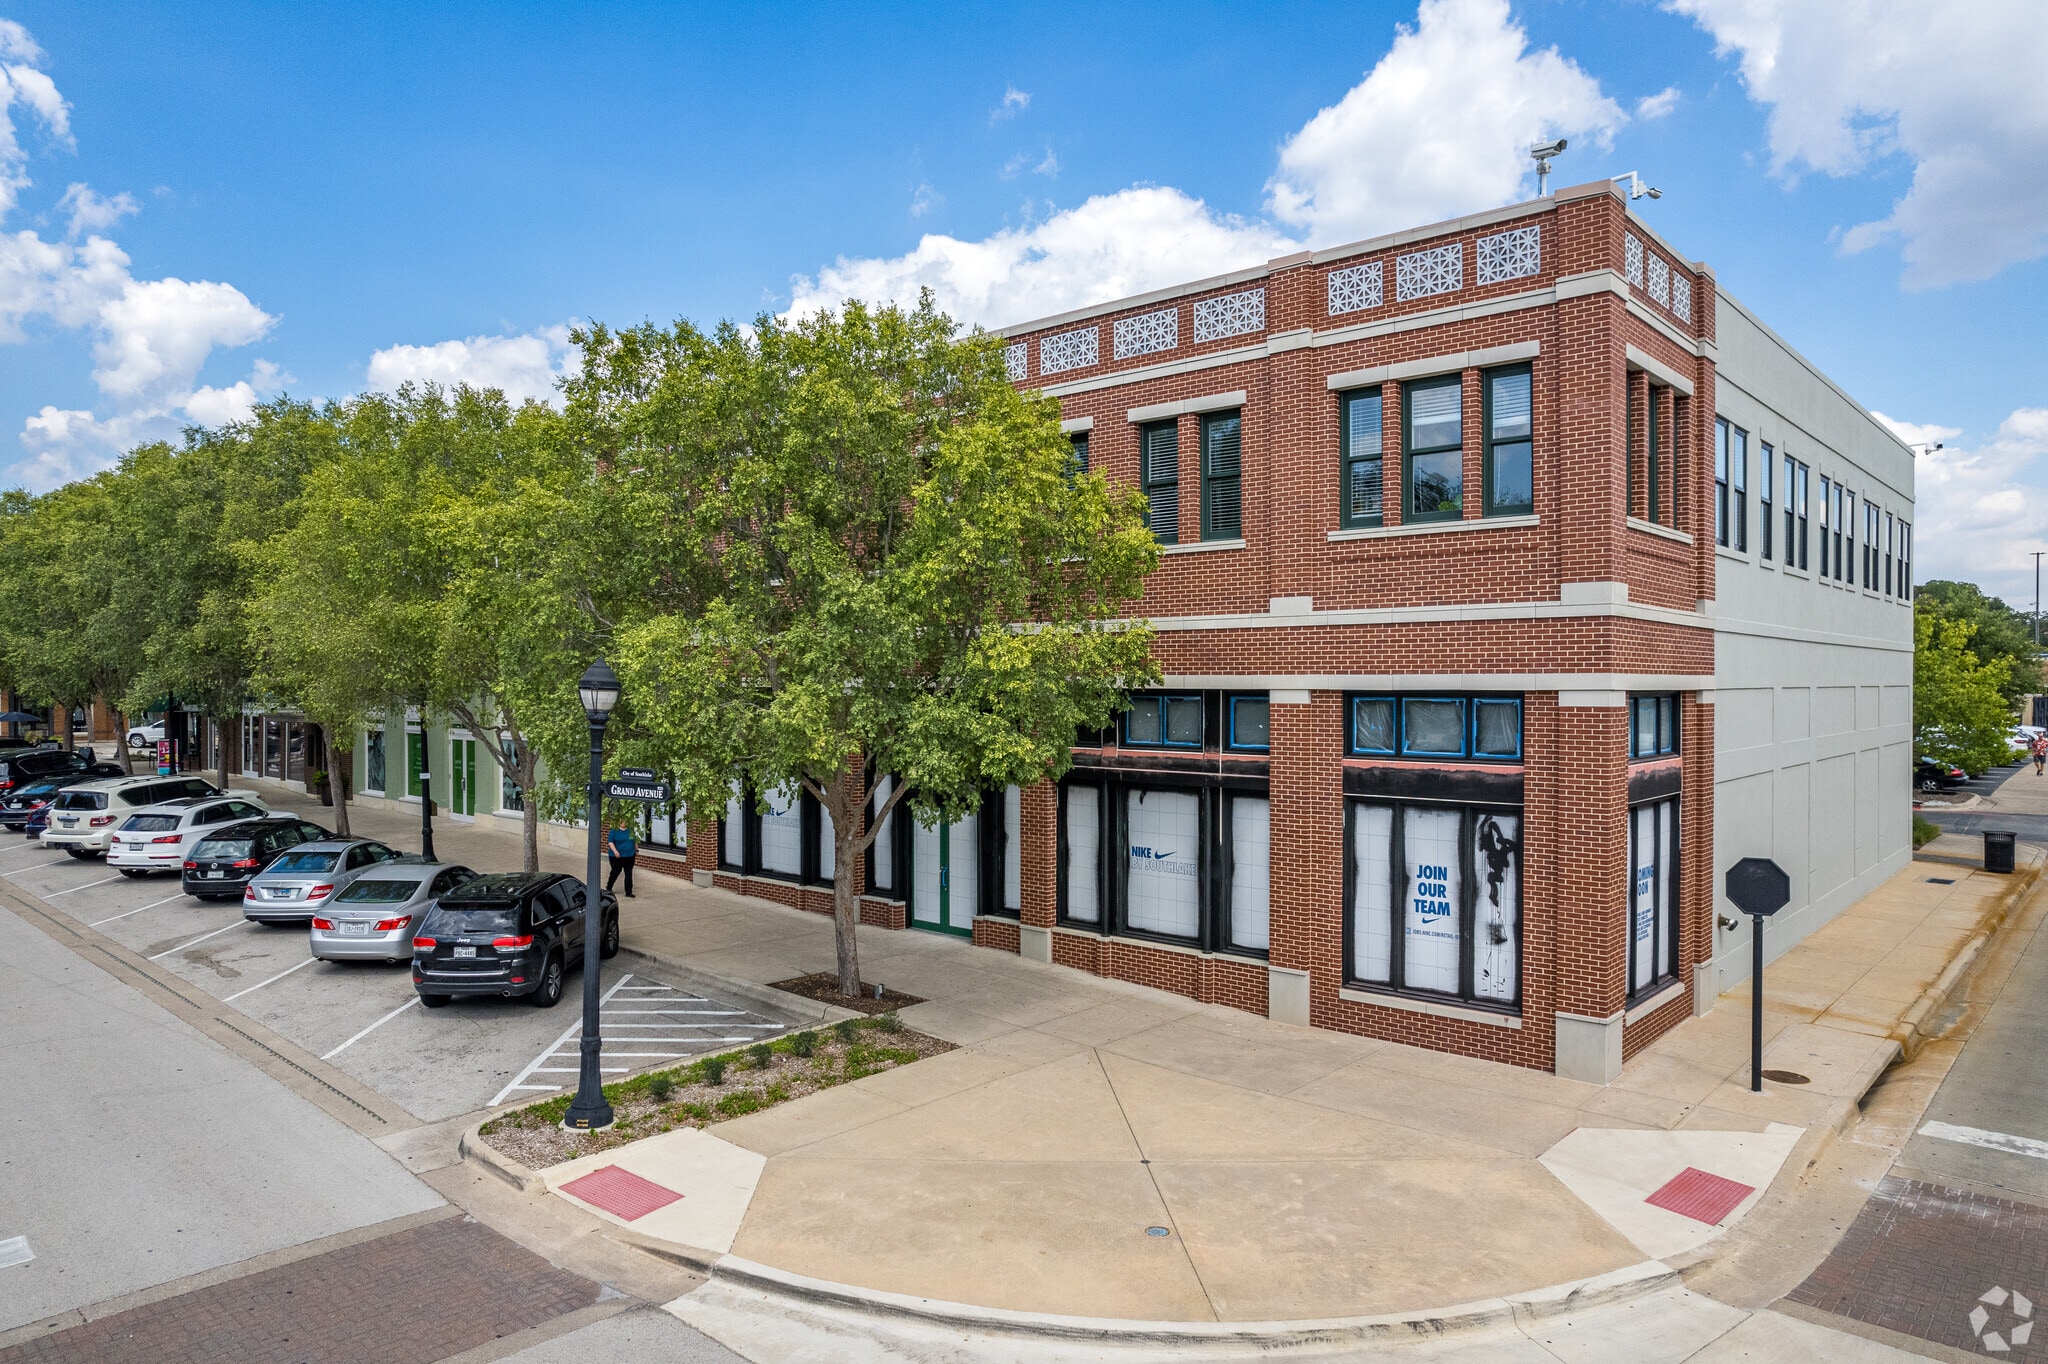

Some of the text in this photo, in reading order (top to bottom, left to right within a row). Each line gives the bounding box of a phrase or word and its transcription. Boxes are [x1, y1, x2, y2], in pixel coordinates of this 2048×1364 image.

[635, 770, 653, 778] Southlake
[611, 784, 664, 799] GRAND AVENUE
[1131, 846, 1152, 859] NIKE
[1131, 858, 1197, 877] BY SOUTHLAKE
[1416, 864, 1448, 881] JOIN
[1417, 882, 1447, 899] OUR
[1637, 880, 1649, 897] OON
[1413, 898, 1451, 917] TEAM
